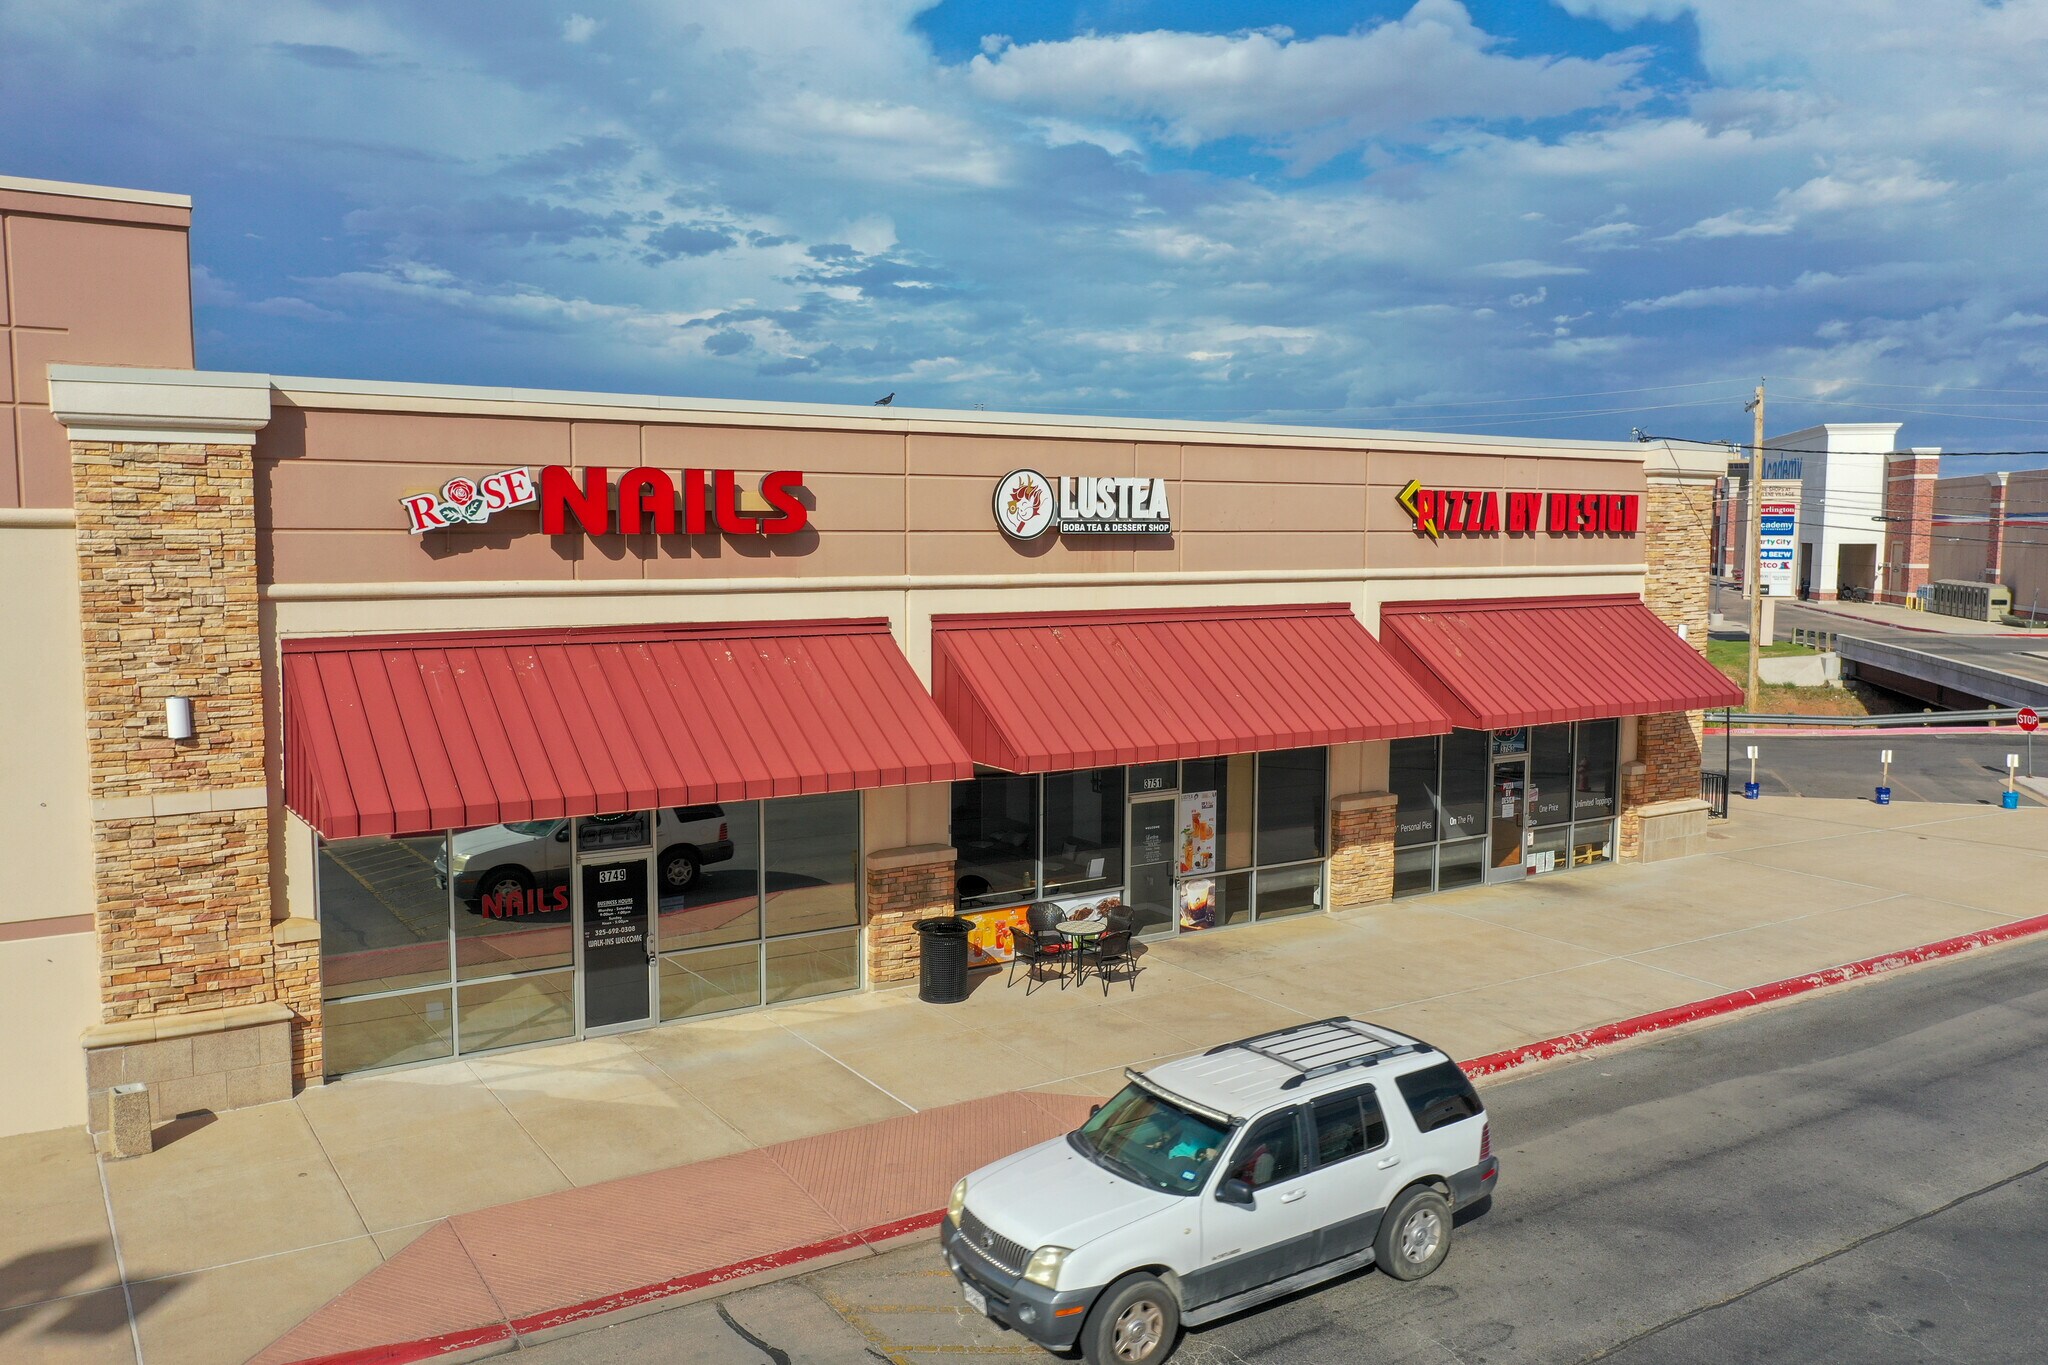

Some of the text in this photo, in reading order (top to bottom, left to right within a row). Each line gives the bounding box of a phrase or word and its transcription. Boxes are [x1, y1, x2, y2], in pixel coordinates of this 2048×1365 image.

[539, 464, 808, 535] NAILS
[1060, 476, 1170, 519] LUSTEA
[1416, 490, 1639, 532] PIZZA BY DESIGN
[1761, 506, 1795, 515] urlington
[1063, 523, 1169, 532] BOBA TEA & DESSERT SHOP
[1761, 522, 1793, 531] cademy
[2018, 714, 2037, 725] STOP
[1144, 778, 1162, 788] 3751
[1539, 804, 1548, 813] One
[1548, 803, 1559, 812] Price
[1575, 796, 1613, 809] Unlimited Toppings
[1449, 814, 1475, 826] On The Fly
[1400, 821, 1422, 833] Personal
[1422, 820, 1432, 830] Pies
[583, 825, 641, 843] OPEN
[600, 869, 626, 883] 3749
[481, 885, 569, 919] NAILS
[597, 900, 618, 908] BUSINESS
[595, 925, 636, 937] 325-692-0308
[588, 934, 643, 948] WALK-INS WELCOME
